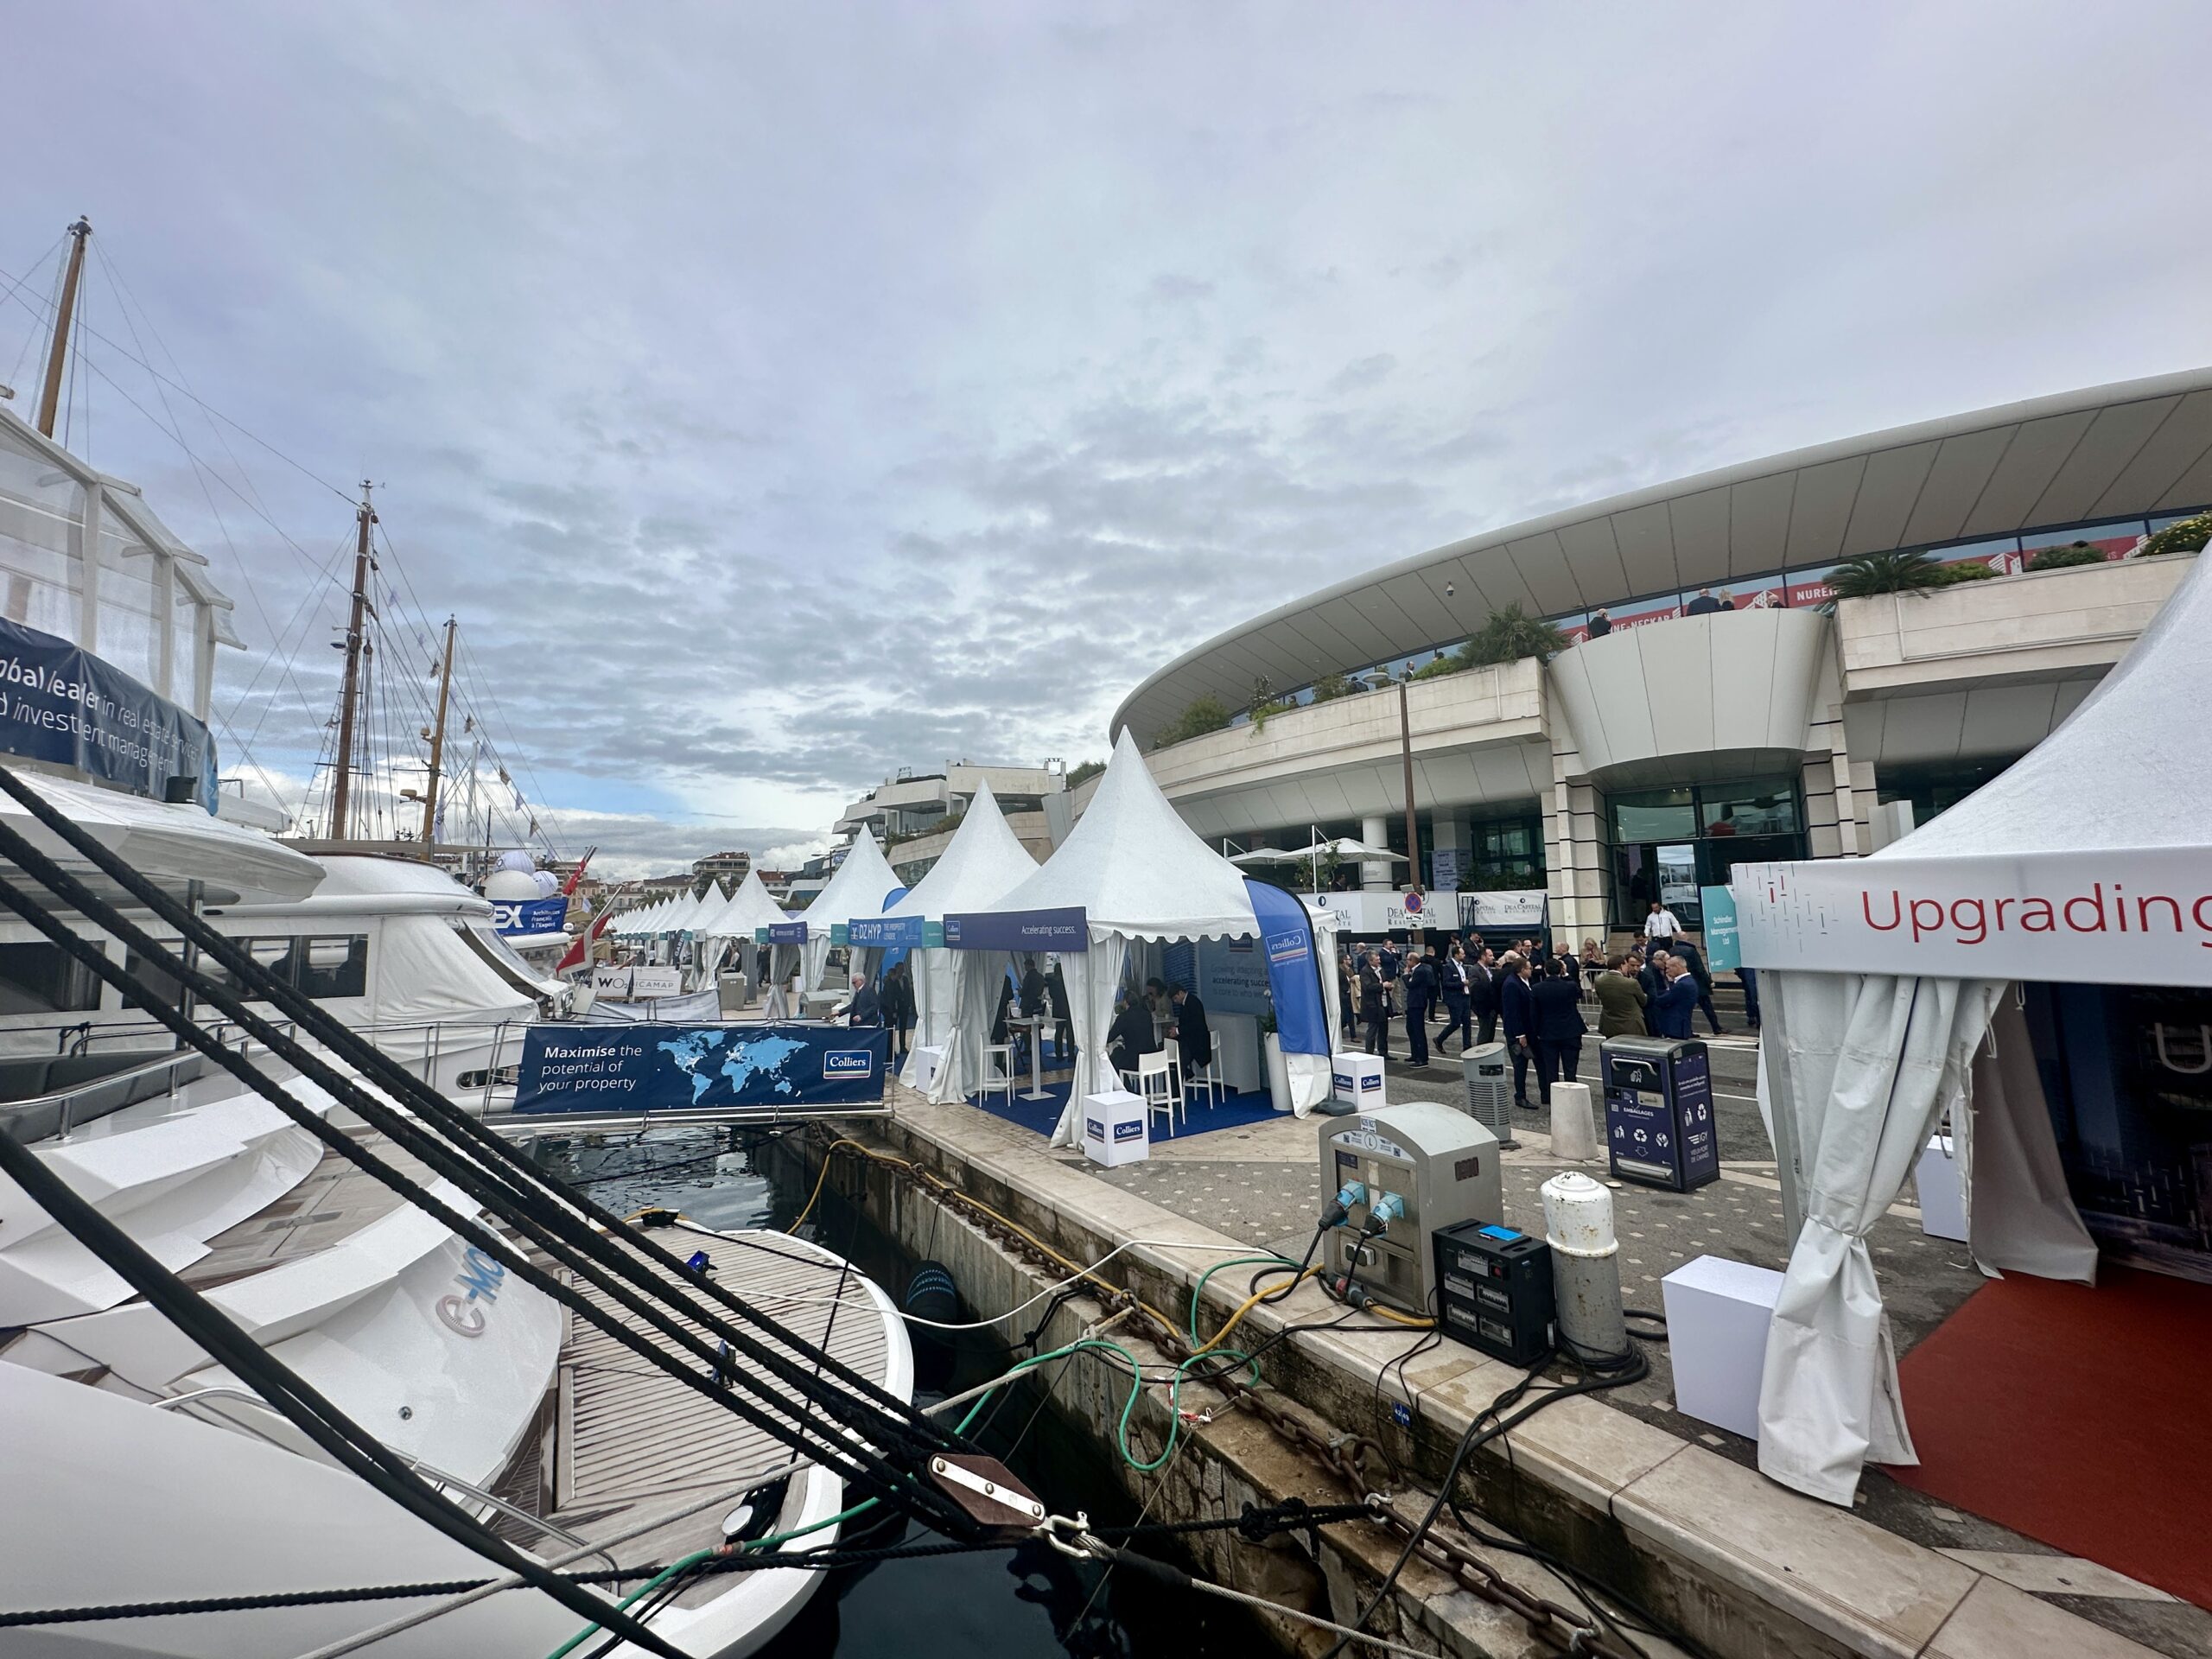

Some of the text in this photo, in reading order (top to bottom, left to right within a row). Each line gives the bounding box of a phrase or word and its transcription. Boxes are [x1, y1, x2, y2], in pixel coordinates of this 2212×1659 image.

[102, 695, 115, 718] in
[118, 706, 140, 729] real
[1862, 883, 2212, 948] Upgrading
[1021, 925, 1077, 938] Accelerating success.
[1212, 976, 1270, 988] accelerating succe
[544, 1045, 642, 1058] Maximise the
[542, 1060, 624, 1077] potential of
[830, 1057, 867, 1067] Colliers
[537, 1078, 636, 1094] your property
[1624, 1107, 1654, 1117] EMBALLAGES
[1116, 1126, 1141, 1135] Colliers
